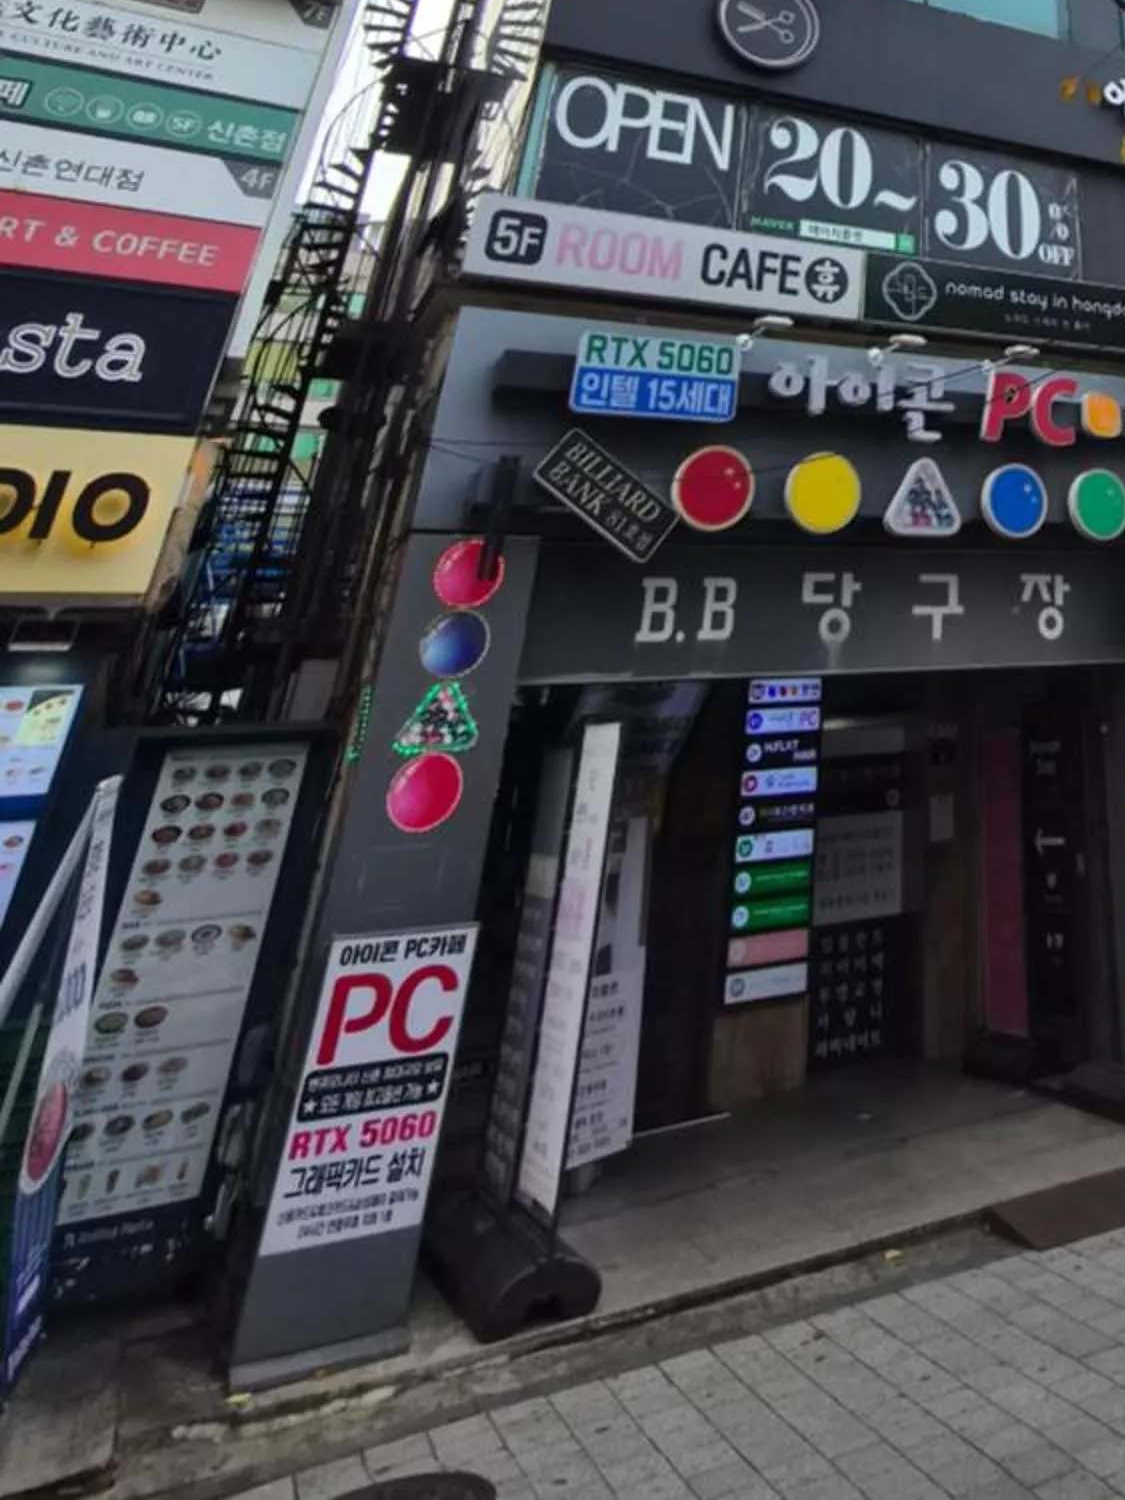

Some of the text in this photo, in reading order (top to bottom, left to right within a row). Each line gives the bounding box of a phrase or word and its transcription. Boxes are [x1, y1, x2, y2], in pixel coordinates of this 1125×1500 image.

[207, 119, 289, 153] 신촌점
[554, 75, 735, 171] OPEN
[0, 151, 145, 193] 신촌연대점
[241, 168, 275, 191] 4F
[54, 225, 80, 248] &
[92, 230, 221, 268] COFFEE
[493, 216, 543, 258] 5F
[556, 221, 684, 282] ROOM
[701, 243, 803, 297] CAFE
[1039, 244, 1075, 268] OFF
[945, 280, 1005, 302] nomad
[1010, 288, 1048, 310] stay
[1052, 295, 1069, 309] in
[585, 333, 734, 376] RTX 5060
[580, 372, 730, 416] 인텔 15세대
[768, 354, 956, 444] 아이콘
[980, 369, 1079, 447] PC
[547, 460, 609, 518] BANK
[564, 440, 662, 524] BILLIARD
[634, 571, 1071, 645] B.B 당구장
[340, 932, 467, 967] 아이콘 PC카페
[315, 963, 459, 1066] PC
[288, 1109, 438, 1161] RTX 5060
[284, 1147, 427, 1200] 그래픽카드 설치
